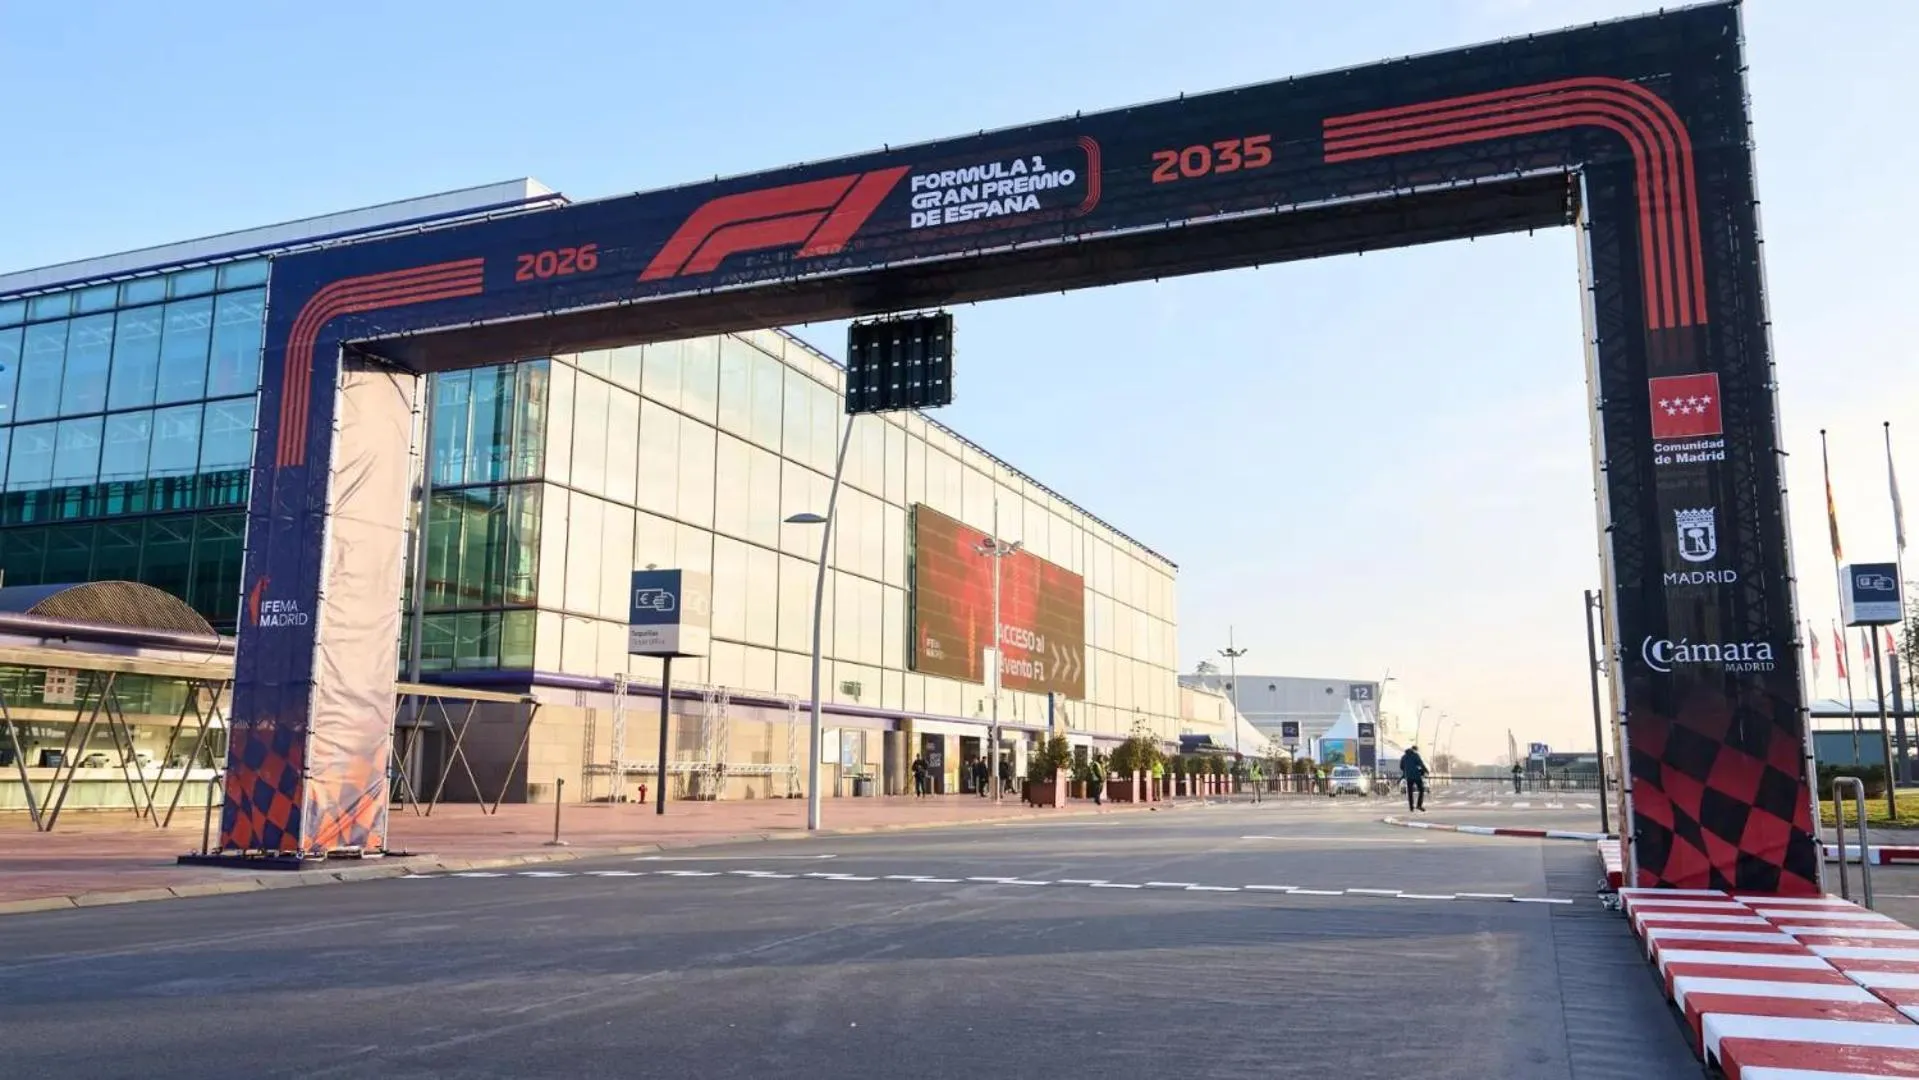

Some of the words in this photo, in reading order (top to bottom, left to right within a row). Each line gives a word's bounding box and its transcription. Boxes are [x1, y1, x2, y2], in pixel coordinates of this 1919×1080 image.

[1152, 135, 1272, 184] 2035
[911, 159, 1028, 191] FORMULA
[1031, 155, 1046, 172] 1
[911, 187, 979, 209] GRAN
[982, 169, 1076, 199] PREMIO
[910, 208, 941, 229] DE
[944, 194, 1041, 223] ESPAÑA
[515, 243, 598, 282] 2026
[1653, 439, 1725, 453] Comunidad
[1654, 454, 1672, 465] de
[1675, 450, 1725, 463] Madrid
[1663, 569, 1737, 586] MADRID
[260, 600, 298, 613] IFEMA
[260, 612, 308, 627] MADRID
[1652, 637, 1774, 663] Cámara
[1725, 662, 1775, 672] MADRID
[1354, 687, 1369, 699] 12
